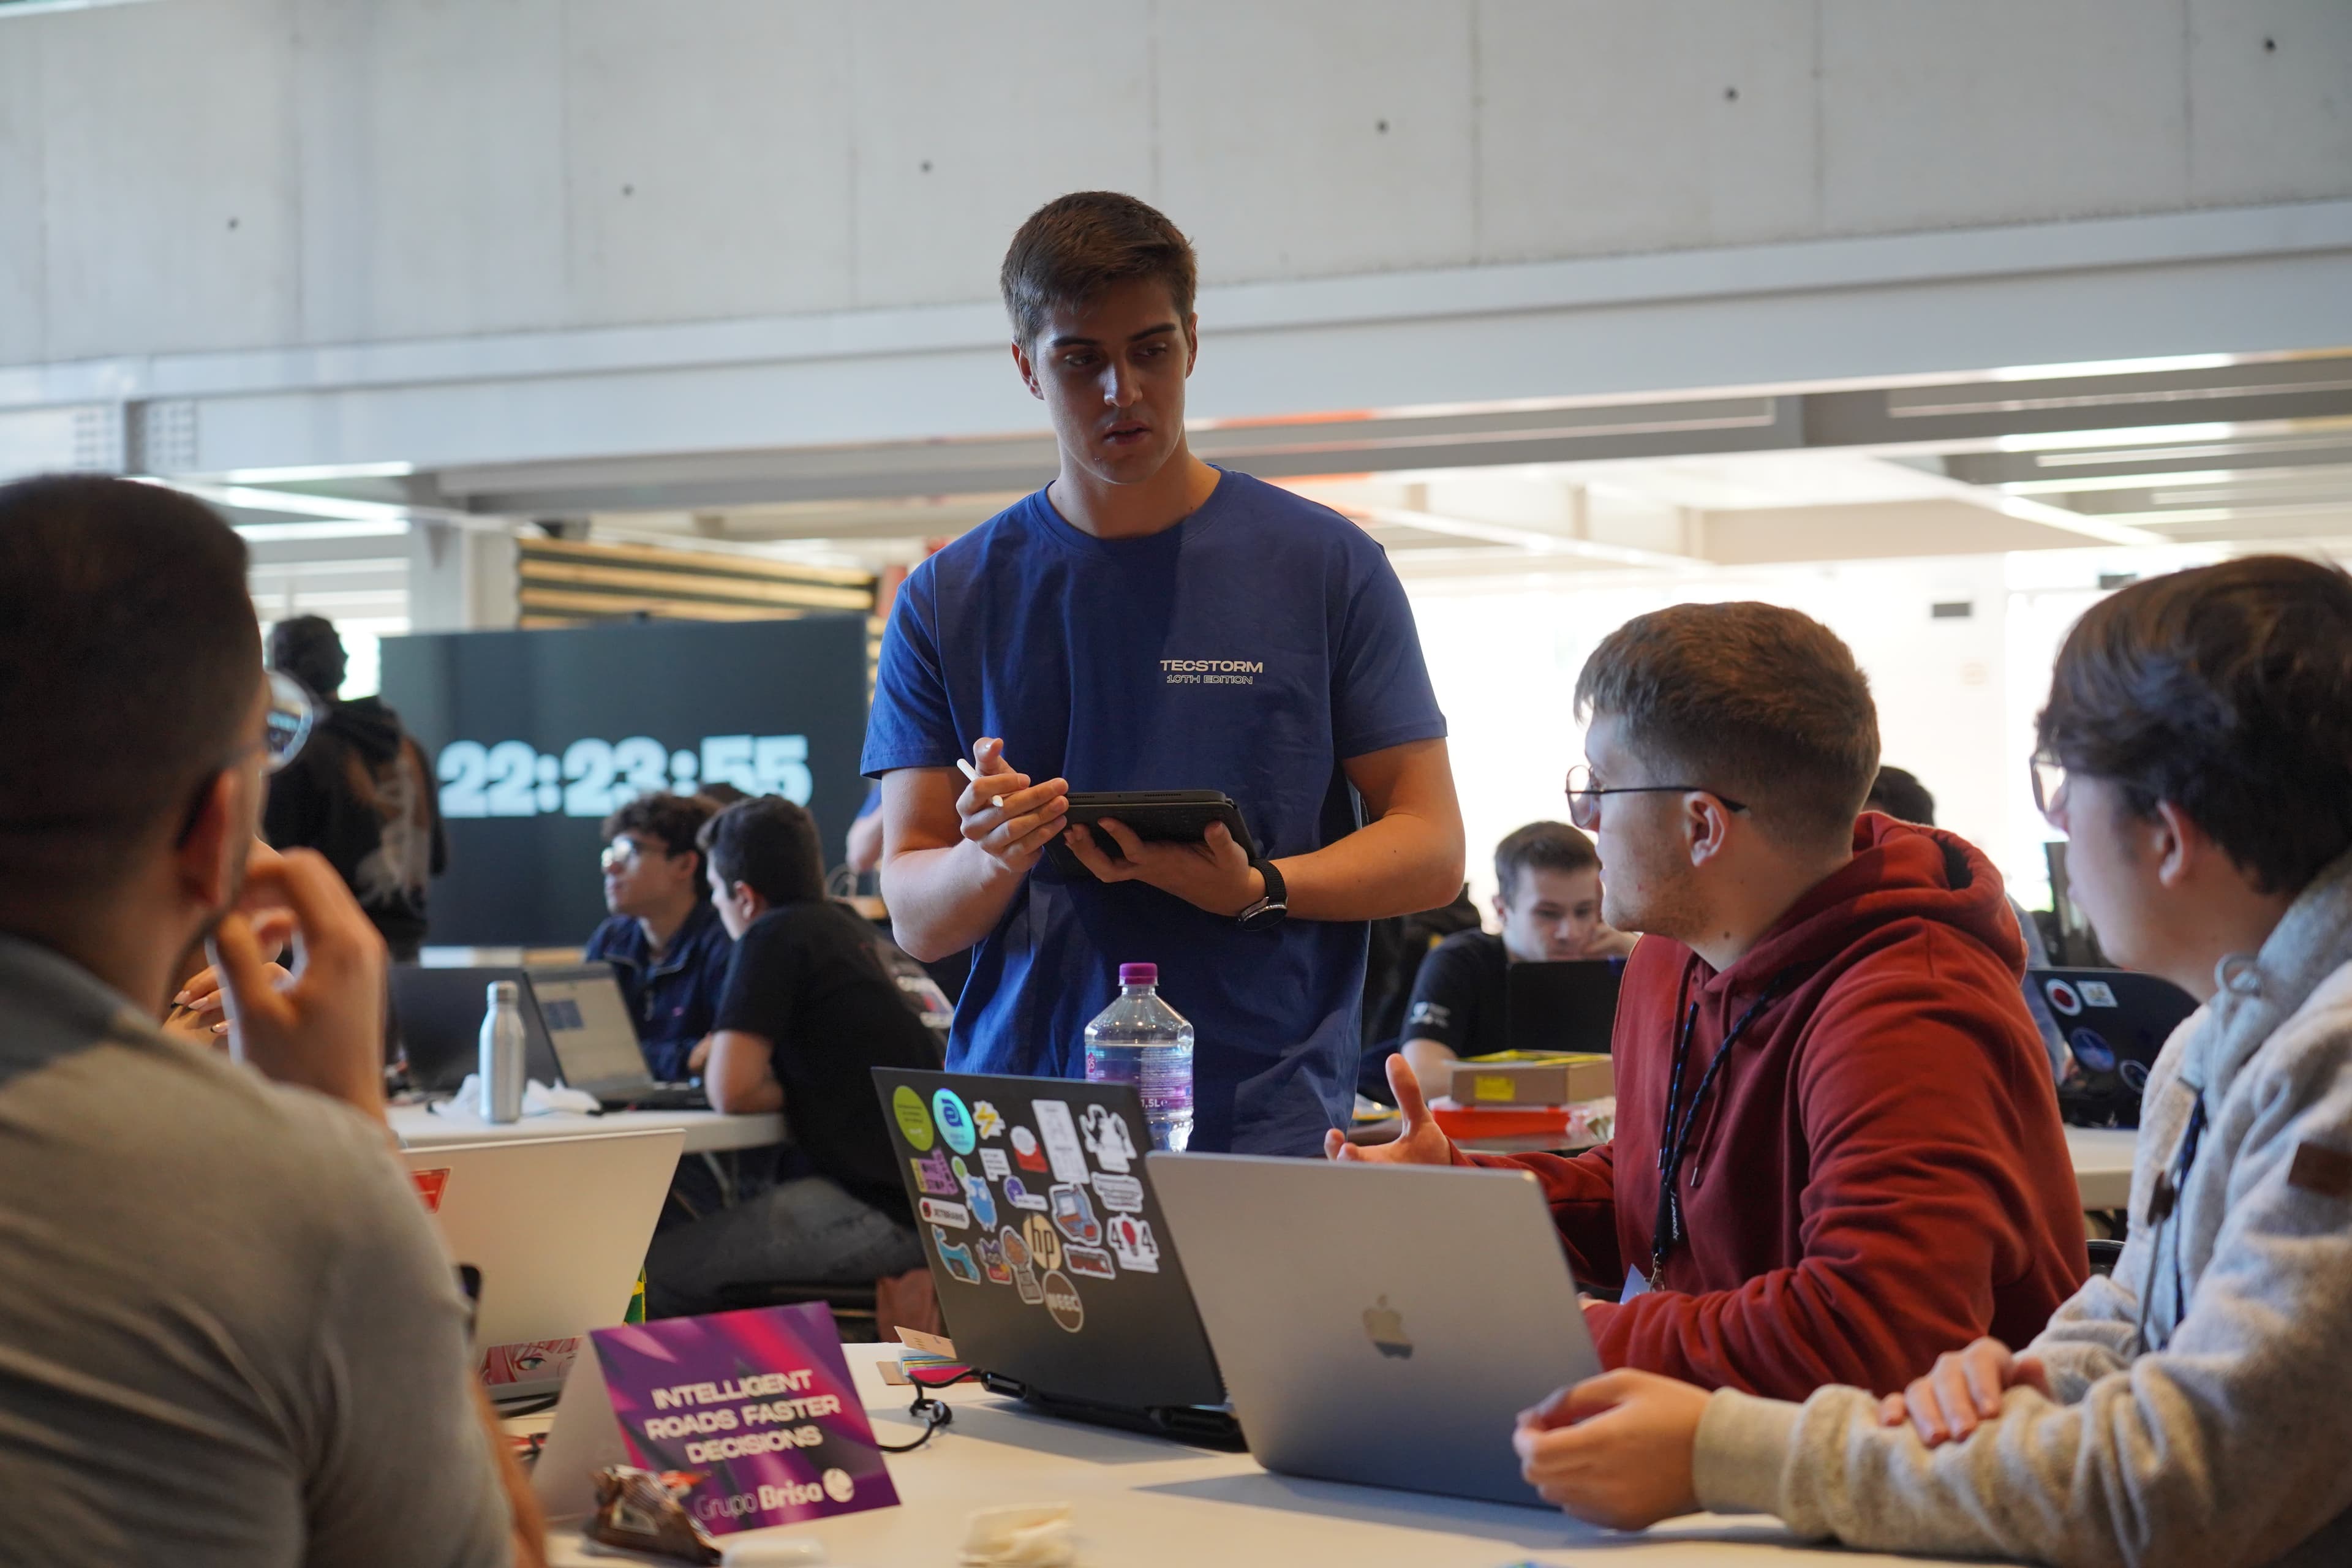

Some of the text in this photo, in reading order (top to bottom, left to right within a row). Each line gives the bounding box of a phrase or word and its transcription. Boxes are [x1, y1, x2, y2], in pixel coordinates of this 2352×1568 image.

[1160, 660, 1264, 673] TECSTORM
[1167, 674, 1253, 685] 10TH EDITION
[436, 734, 813, 818] 22:23:55
[650, 1368, 813, 1410] INTELLIGENT
[643, 1395, 842, 1441] ROADS FASTER
[685, 1425, 824, 1464] DECISIONS
[759, 1480, 824, 1510] Brisa
